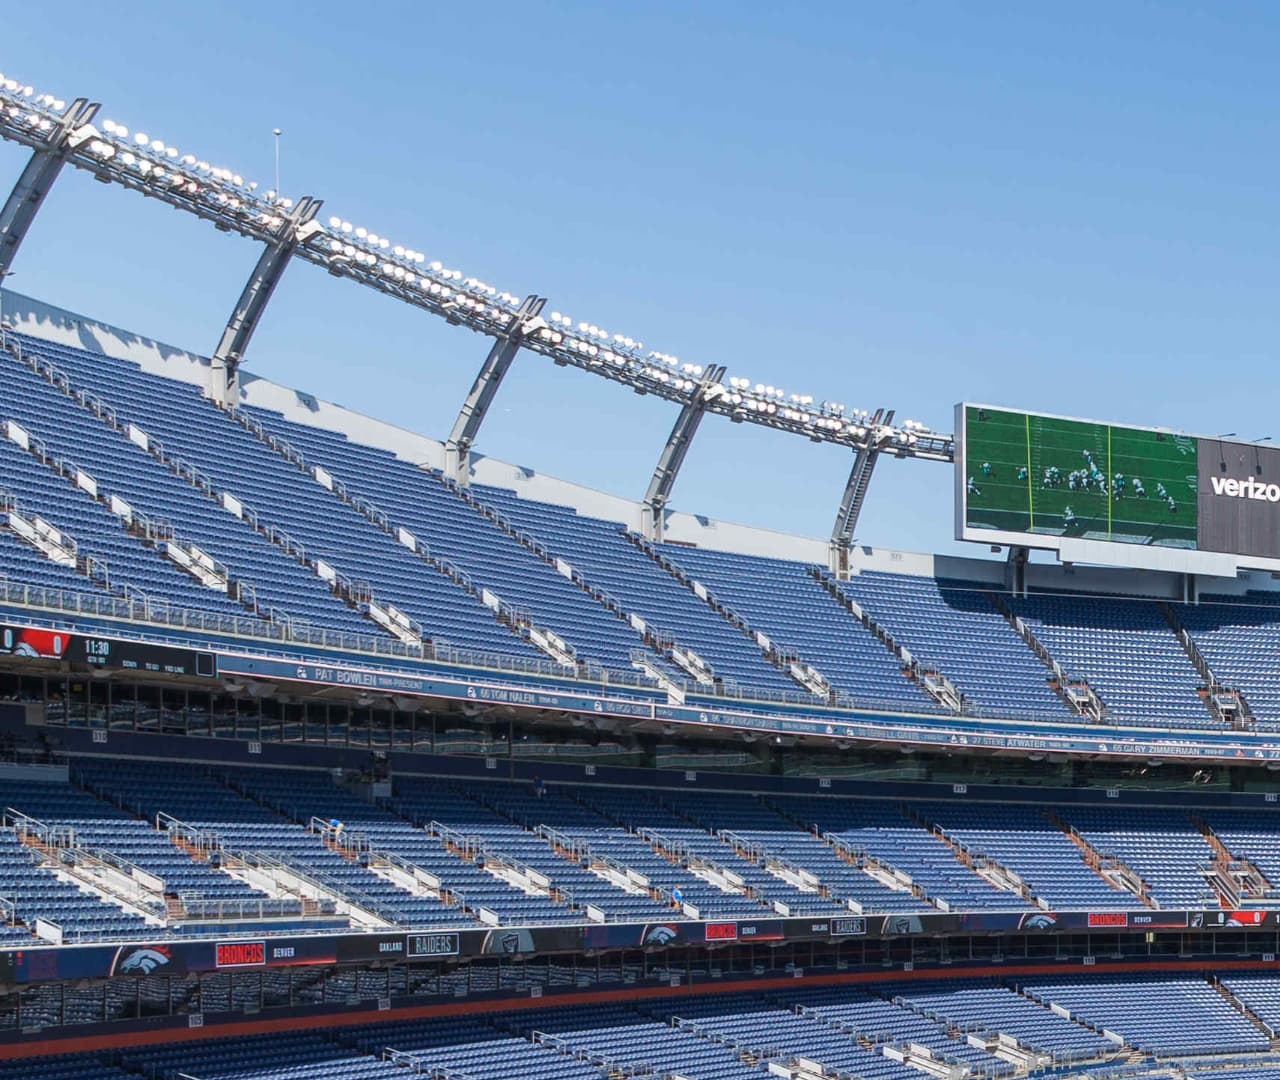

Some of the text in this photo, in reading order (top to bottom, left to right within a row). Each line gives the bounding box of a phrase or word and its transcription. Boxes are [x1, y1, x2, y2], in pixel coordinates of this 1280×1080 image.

[4, 629, 12, 648] 0
[53, 635, 62, 654] 0
[85, 639, 109, 655] 11:30
[315, 668, 376, 686] PAT BOWLEN
[1007, 738, 1046, 748] ATWATER
[1123, 744, 1146, 753] GARY
[1149, 746, 1200, 755] ZIMMERMAN
[1089, 914, 1127, 925] BRONCOS
[1218, 913, 1224, 923] 0
[1254, 913, 1260, 922] 0
[836, 919, 861, 932] RAIDERS
[415, 936, 452, 953] RAIDERS
[217, 943, 263, 964] BRONCOS
